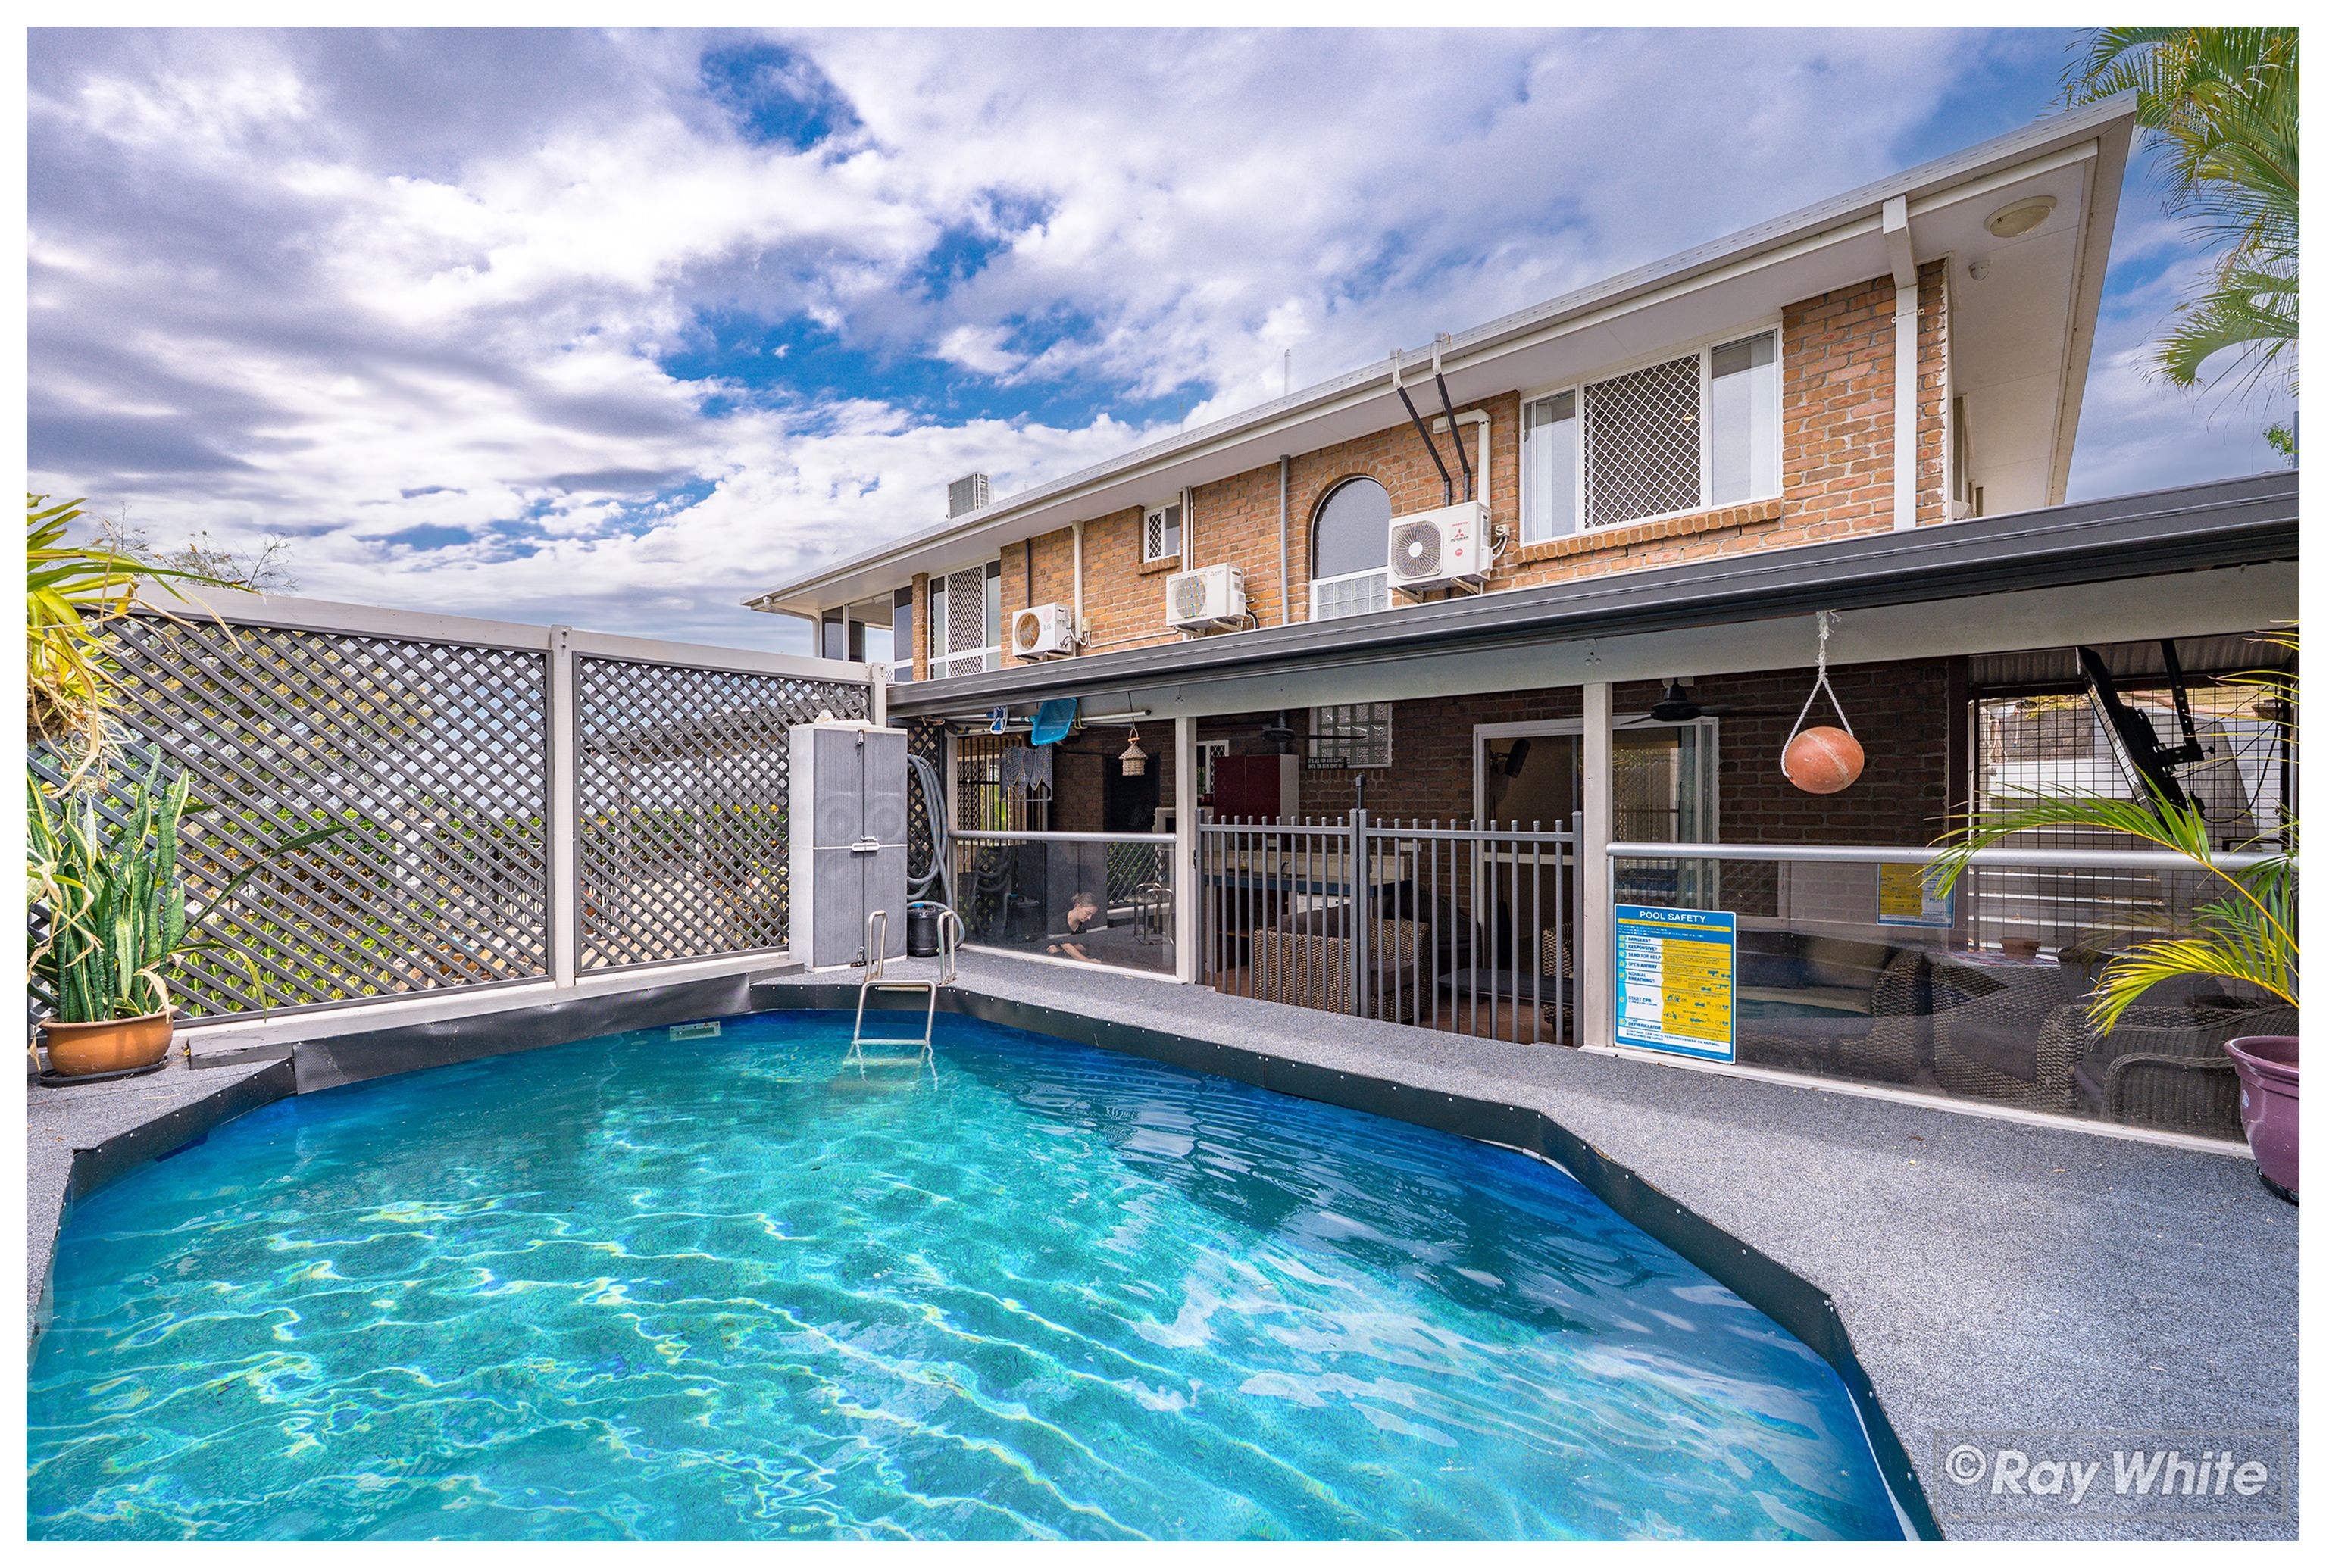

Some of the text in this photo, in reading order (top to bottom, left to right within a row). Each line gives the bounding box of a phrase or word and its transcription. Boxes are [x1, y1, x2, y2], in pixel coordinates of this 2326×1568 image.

[1640, 911, 1706, 923] POOL SAFETY
[1628, 1021, 1662, 1030] DEFIBRILLATOR
